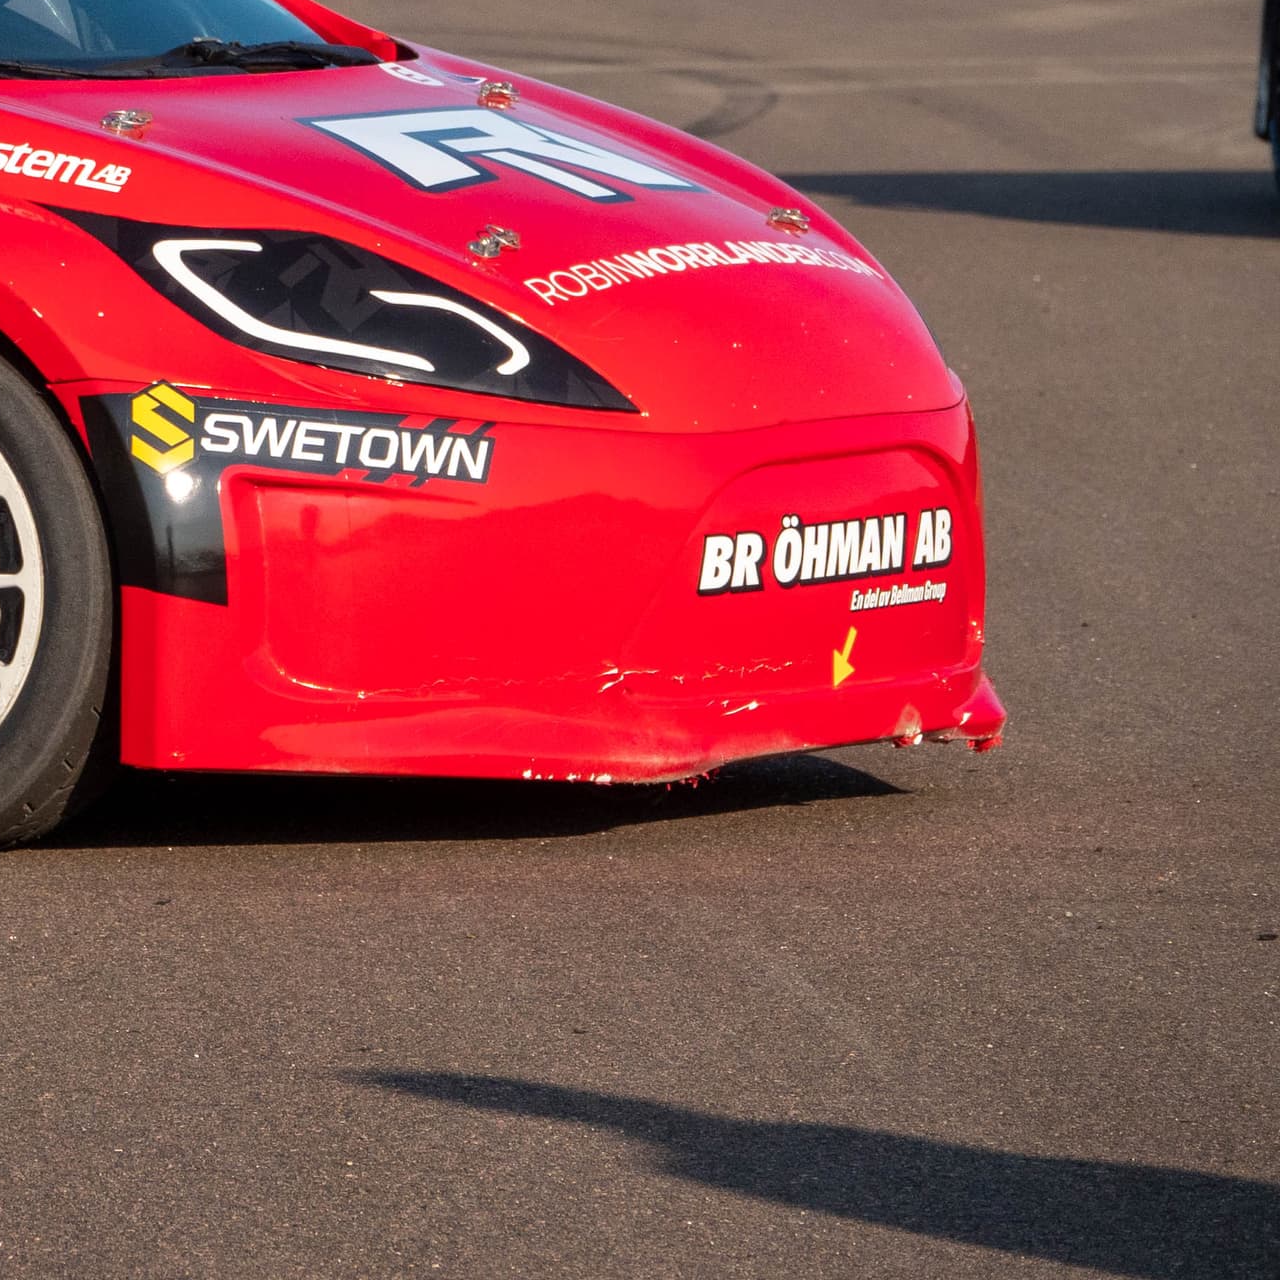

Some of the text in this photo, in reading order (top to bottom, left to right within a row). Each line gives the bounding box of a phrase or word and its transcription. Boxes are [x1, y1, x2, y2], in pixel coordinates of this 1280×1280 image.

[200, 413, 489, 479] SWETOWN
[698, 508, 953, 591] BR ÖHMAN AB
[850, 589, 864, 611] En
[924, 579, 947, 603] Group
